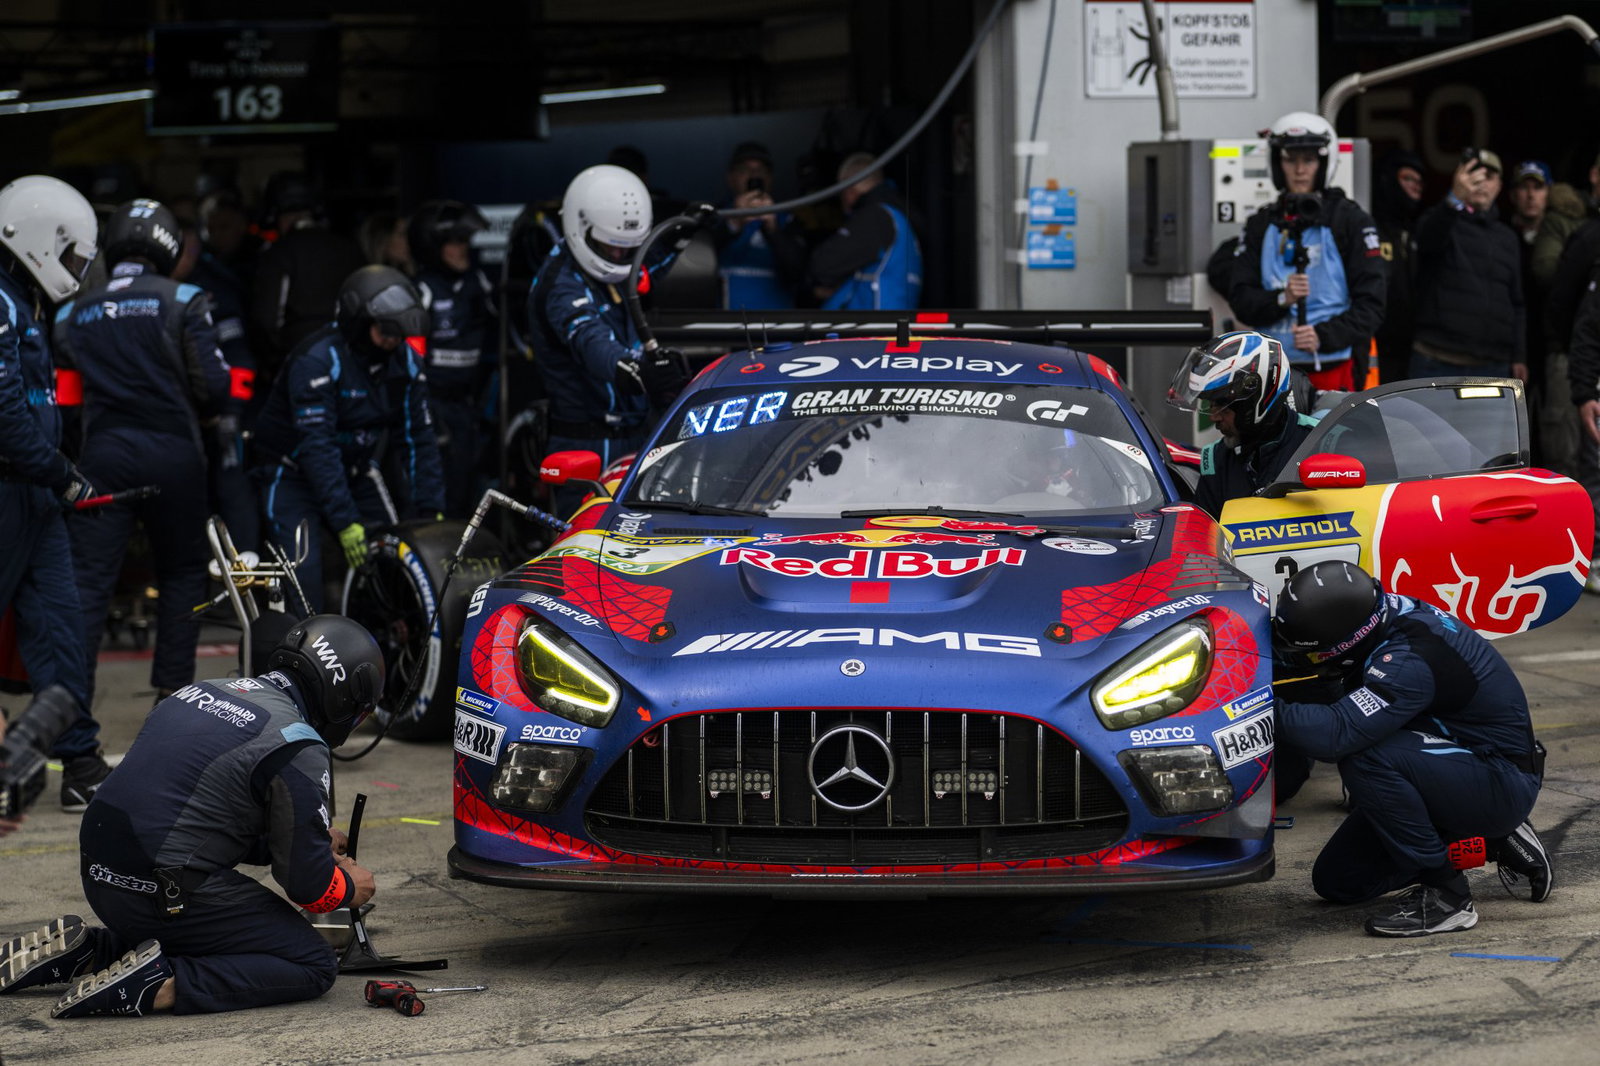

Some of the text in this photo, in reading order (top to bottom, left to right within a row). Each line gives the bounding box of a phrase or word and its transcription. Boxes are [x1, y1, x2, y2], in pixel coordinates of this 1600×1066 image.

[1181, 33, 1241, 47] GEFAHR
[213, 83, 284, 122] 163
[1220, 202, 1233, 221] 9
[851, 354, 1024, 377] viaplay
[791, 388, 872, 409] GRAN
[682, 391, 788, 436] VER
[792, 404, 998, 417] THE REAL DRIVING SIMULATOR
[1238, 519, 1348, 542] RAVENOL
[608, 547, 650, 559] 3
[719, 547, 1027, 579] Red Bull
[787, 628, 1042, 657] AMG
[1337, 613, 1381, 653] Red Bull
[311, 634, 347, 686] WNR
[213, 699, 257, 722] WINWARD
[466, 695, 494, 710] MICHELIN
[1242, 691, 1270, 710] MICHELIN
[1351, 692, 1373, 716] FILTER
[1358, 689, 1379, 712] MANN
[205, 704, 249, 728] RACING
[89, 864, 158, 894] alpinestars
